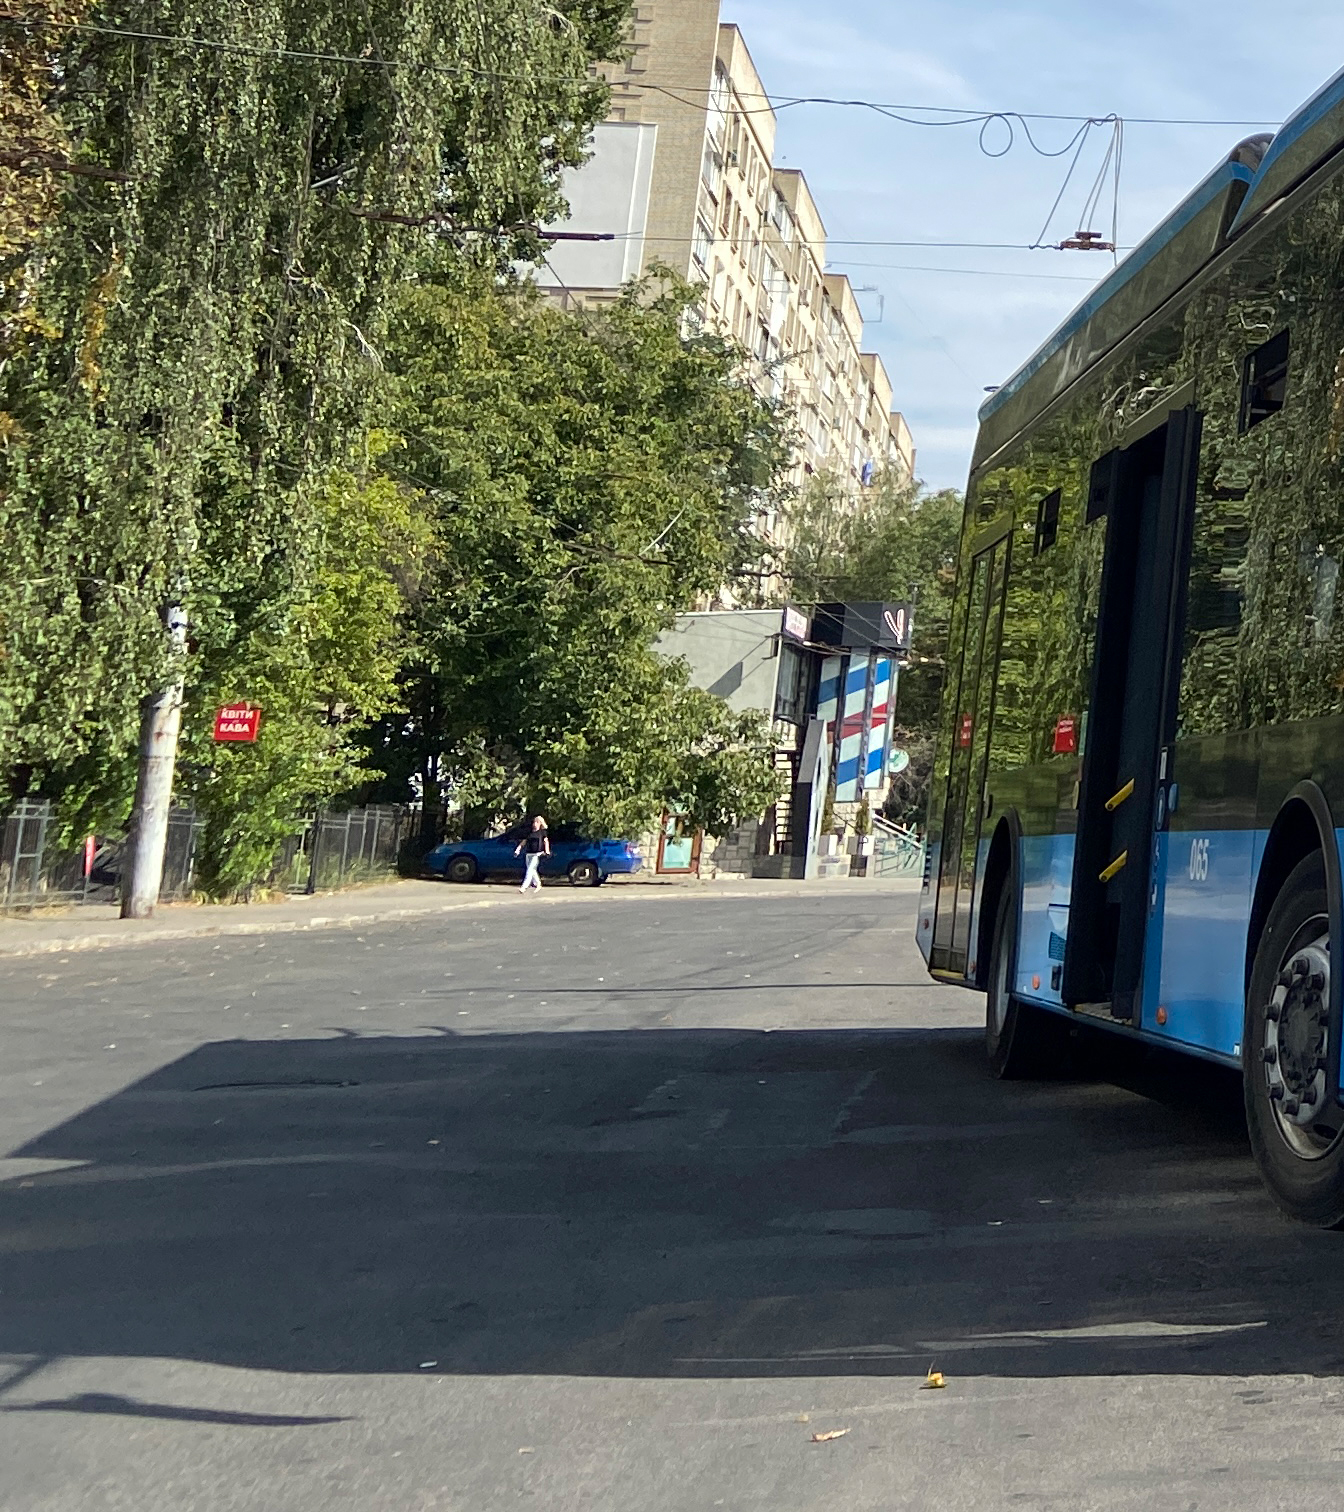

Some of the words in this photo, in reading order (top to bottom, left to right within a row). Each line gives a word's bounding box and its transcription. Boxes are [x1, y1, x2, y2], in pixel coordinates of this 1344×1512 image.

[221, 710, 254, 719] КВІТИ
[220, 723, 249, 733] КАВА
[1189, 839, 1210, 881] 065
